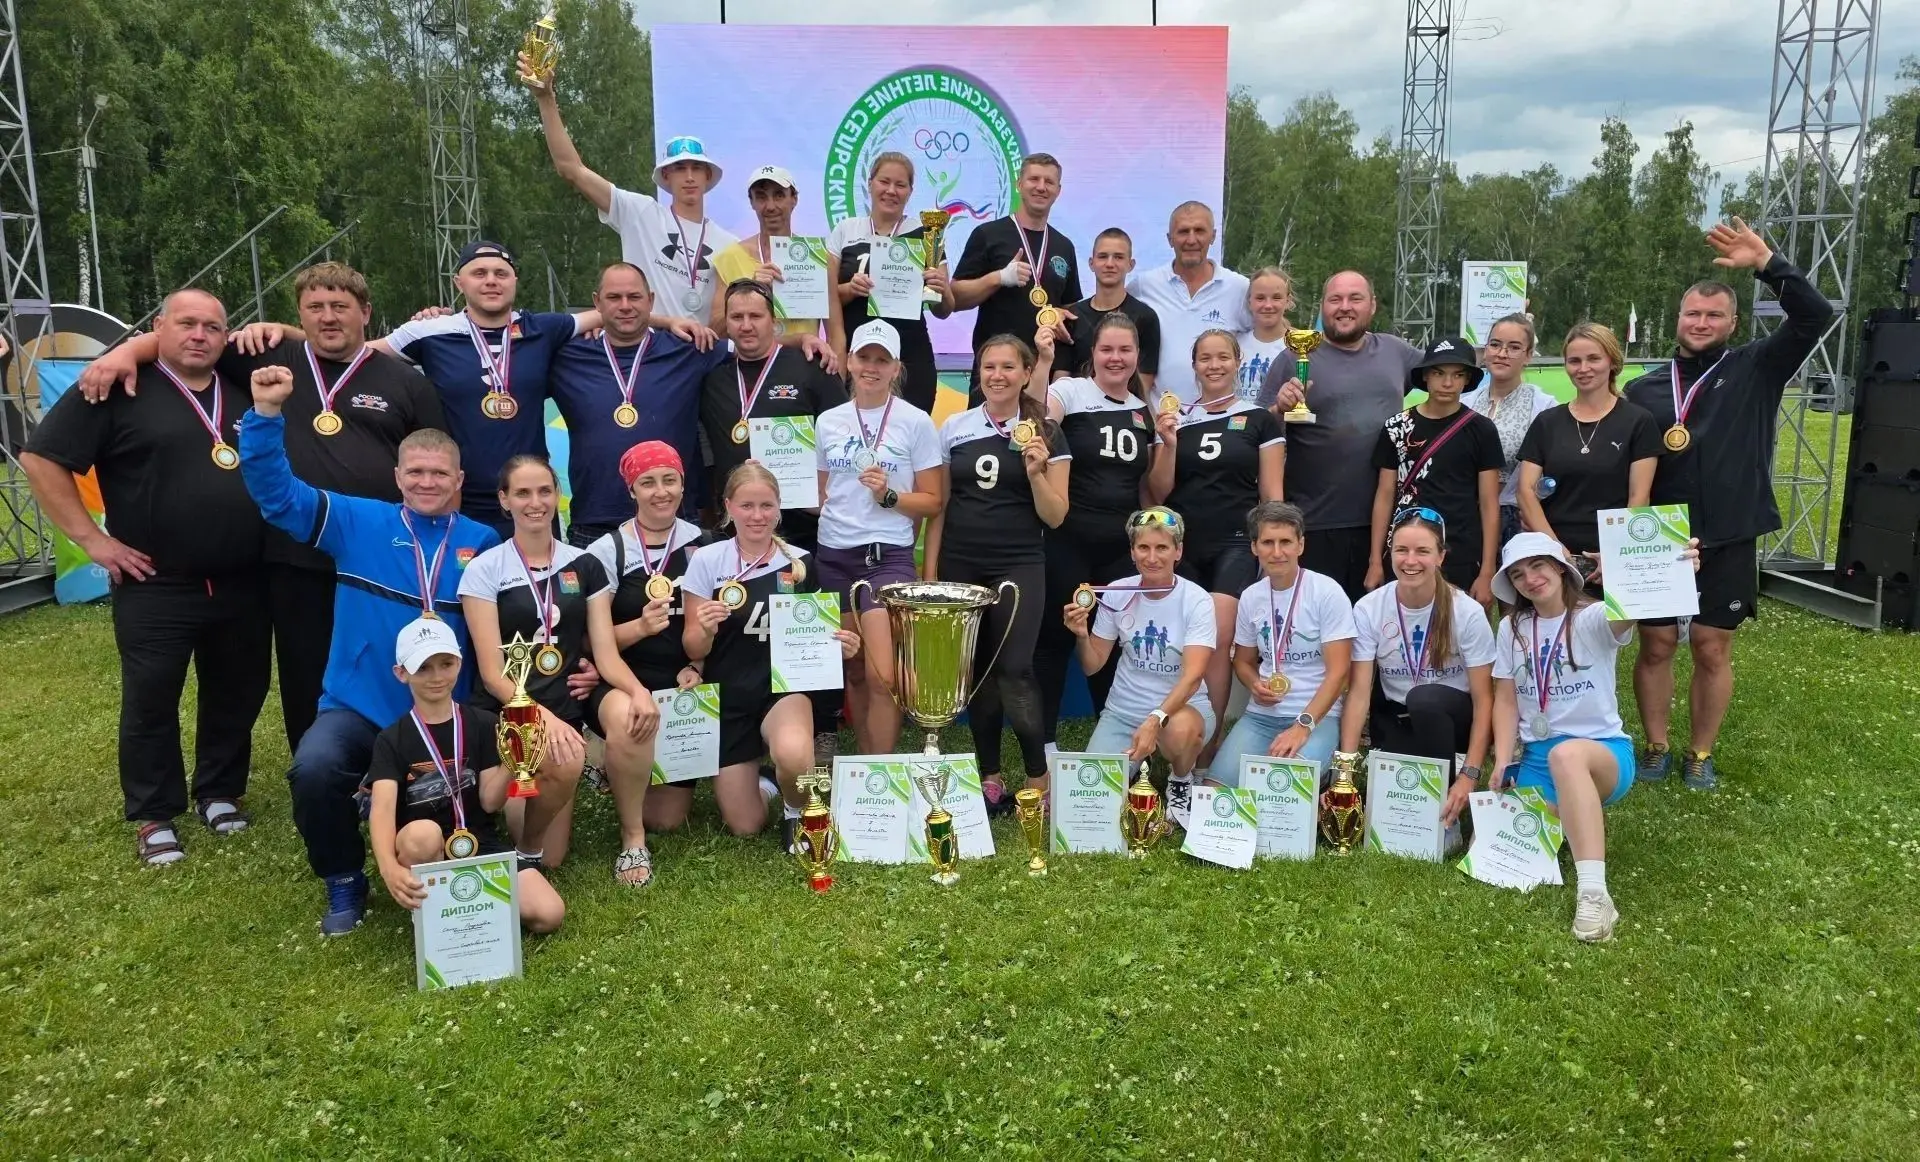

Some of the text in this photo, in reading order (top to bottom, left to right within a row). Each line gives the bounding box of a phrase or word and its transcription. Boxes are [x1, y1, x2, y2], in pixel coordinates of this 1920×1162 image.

[654, 258, 710, 284] UNDER AROUR
[881, 264, 914, 272] ДИПЛОМ
[1387, 419, 1415, 443] STYLE
[1100, 425, 1138, 461] 10
[1198, 433, 1222, 460] 5
[765, 447, 803, 456] ДИПЛОМ
[975, 454, 999, 489] 9
[1620, 544, 1672, 556] ДИПЛОМ
[533, 603, 560, 643] 2
[743, 601, 770, 642] 4
[785, 626, 826, 635] ДИПЛОМ
[1149, 662, 1182, 673] СПОР
[1548, 680, 1594, 696] СПОРТА
[666, 717, 706, 729] ДИПЛОМ
[942, 794, 969, 805] ПЛОМ
[1070, 789, 1110, 798] ДИПЛОМ
[1258, 793, 1299, 805] ДИПЛОМ
[1386, 791, 1428, 802] ДИПЛОМ
[855, 797, 895, 806] ДИПЛОМ
[1204, 819, 1243, 829] ДИПЛОМ
[1496, 830, 1540, 854] ДИПЛОМ
[441, 902, 494, 918] ДИПЛОМ
